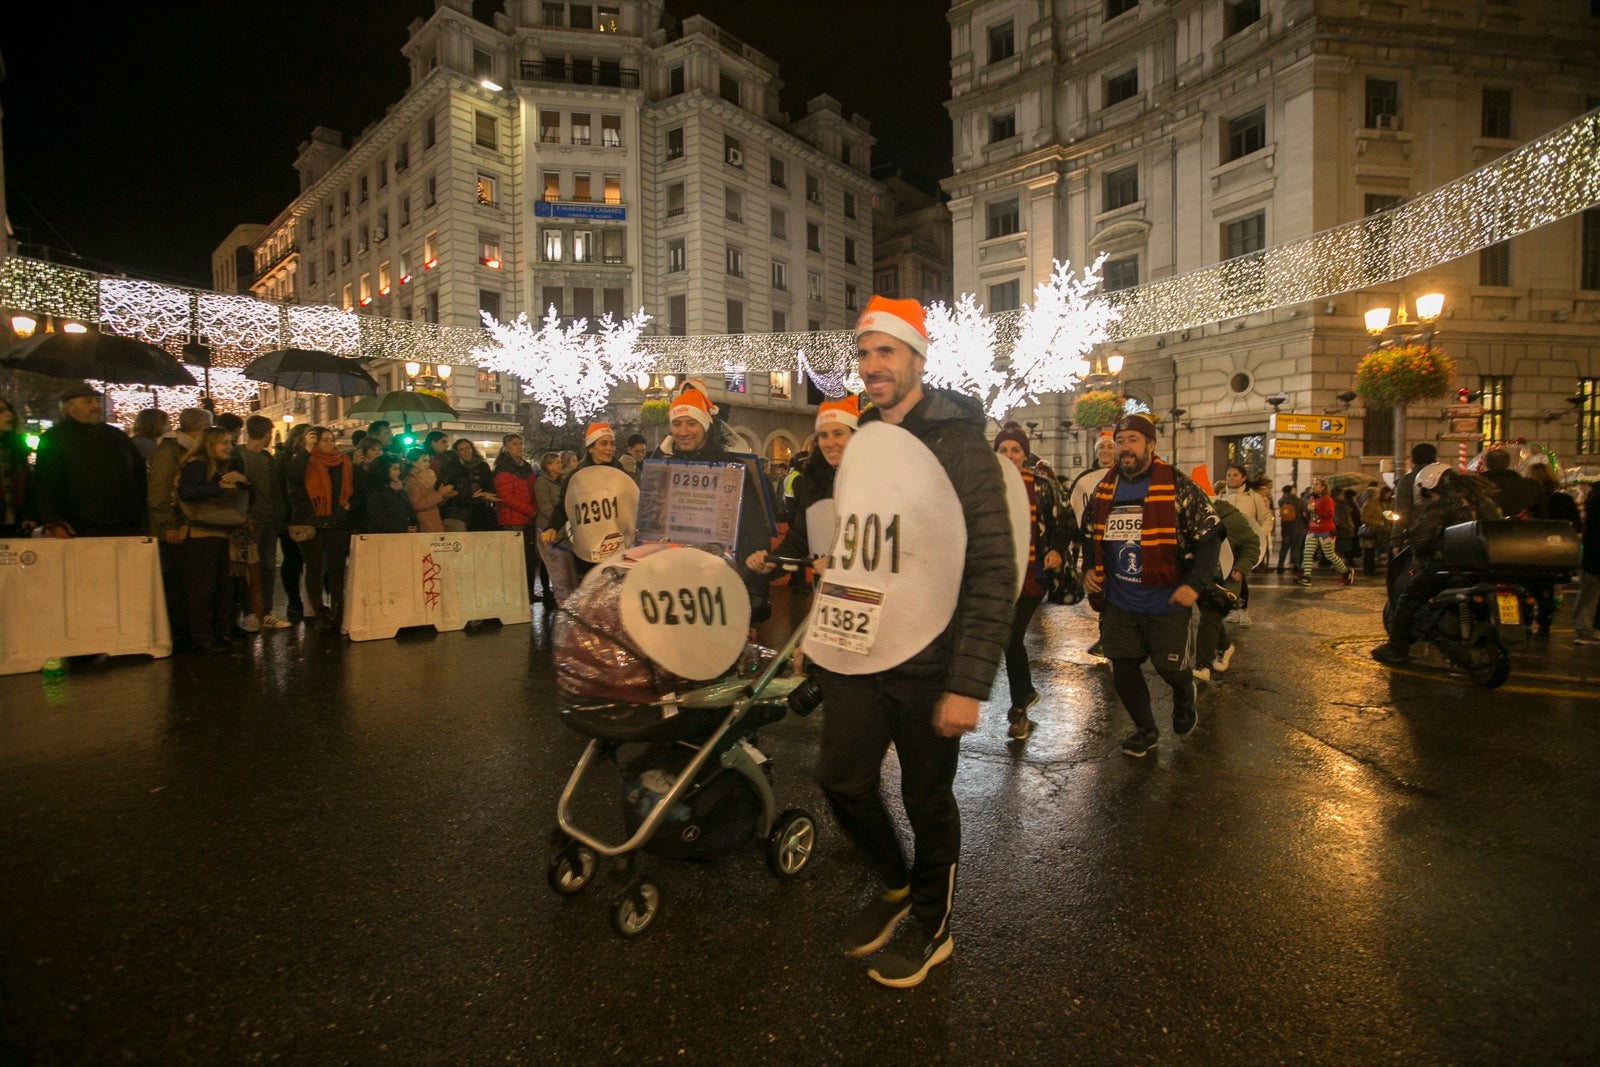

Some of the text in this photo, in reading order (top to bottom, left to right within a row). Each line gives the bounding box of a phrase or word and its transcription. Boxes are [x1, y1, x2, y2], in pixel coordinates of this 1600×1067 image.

[673, 474, 718, 488] 02901
[574, 496, 618, 525] 02901
[1110, 520, 1142, 530] 2056
[827, 513, 900, 574] 901
[640, 586, 726, 626] 02901
[821, 606, 869, 634] 1382
